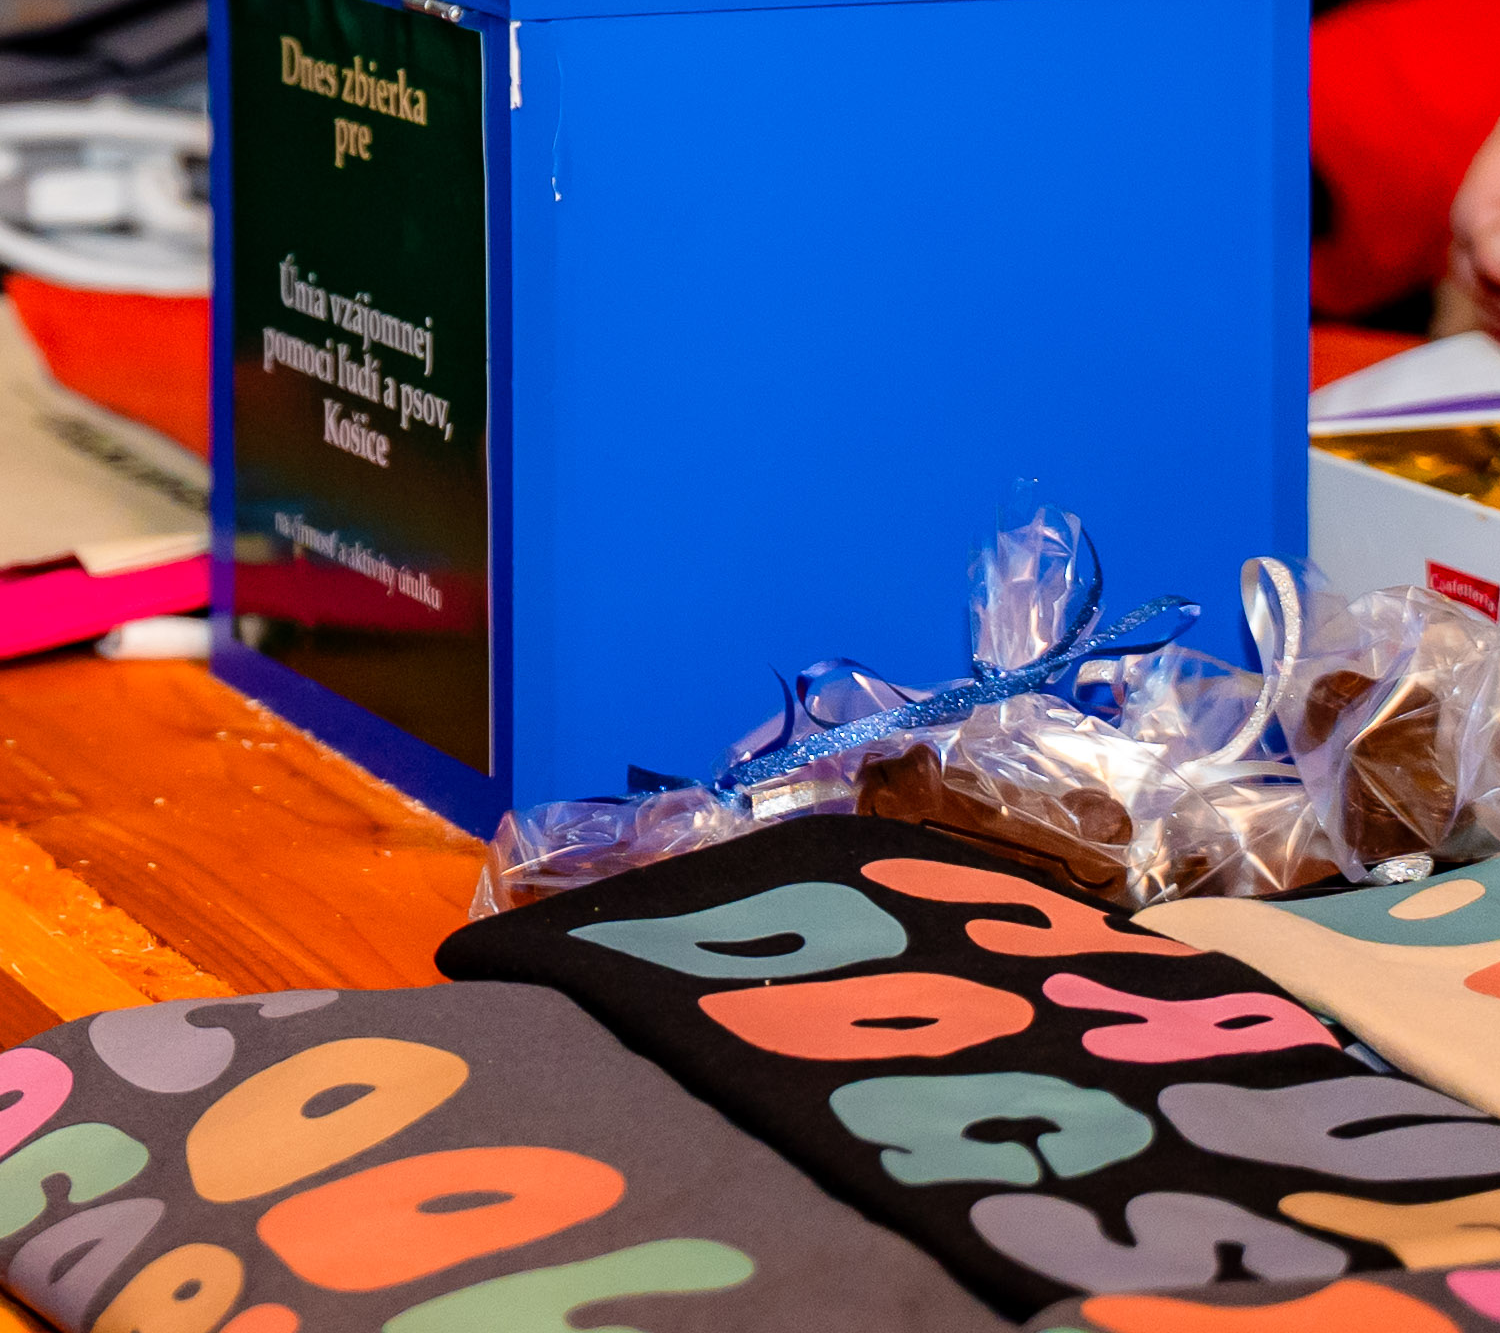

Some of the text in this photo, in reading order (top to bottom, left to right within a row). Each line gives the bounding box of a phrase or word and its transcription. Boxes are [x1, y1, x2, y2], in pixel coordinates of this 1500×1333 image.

[280, 35, 428, 126] Dnes zbierka
[334, 118, 373, 169] pre
[279, 253, 434, 377] Únia vzájomnej
[263, 327, 453, 442] pomoci ľudí a psov,
[323, 398, 391, 469] Košice
[397, 565, 442, 612] útulku
